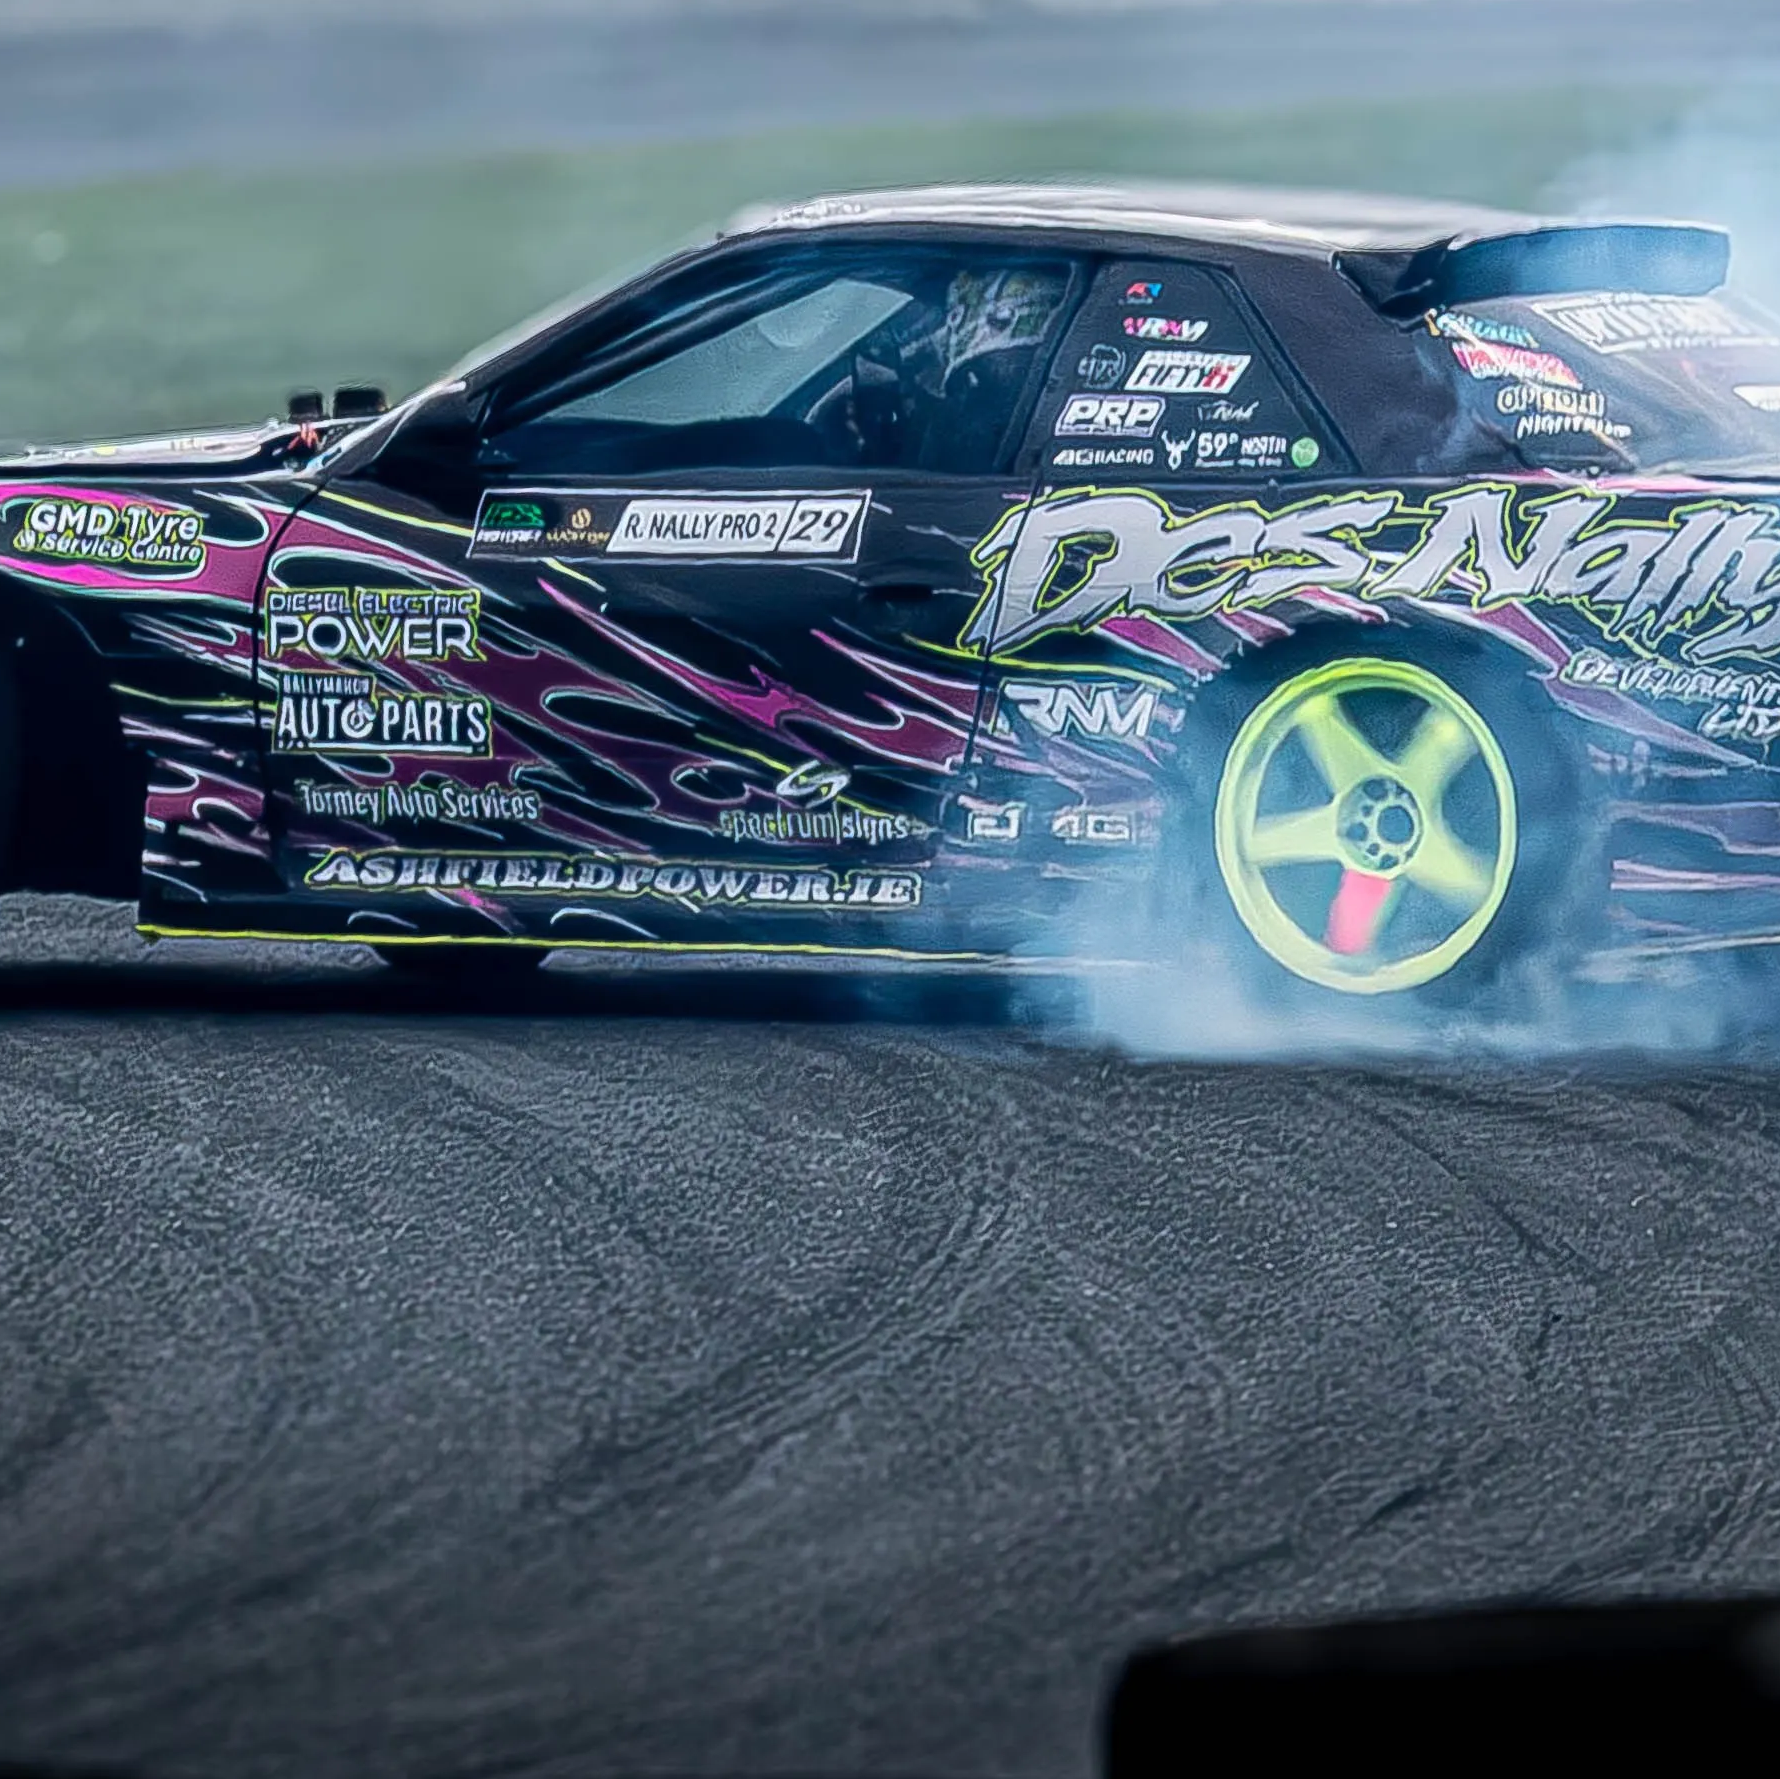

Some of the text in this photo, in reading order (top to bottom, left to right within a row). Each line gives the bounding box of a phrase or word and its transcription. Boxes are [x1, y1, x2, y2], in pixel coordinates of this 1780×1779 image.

[1063, 399, 1160, 428] PRP
[30, 504, 198, 545] GMD Tyre
[624, 514, 644, 538] R.
[648, 514, 718, 540] NALLY
[718, 514, 763, 539] PRO
[764, 513, 778, 537] 2
[787, 509, 849, 542] 29
[965, 484, 1399, 650] Des
[358, 594, 474, 615] ELECTRIC
[270, 616, 474, 658] POWER
[278, 697, 487, 743] AUTO PARTS
[298, 785, 539, 822] Tormey Auto Services
[313, 855, 915, 905] ASHFIELDPOWER.IE
